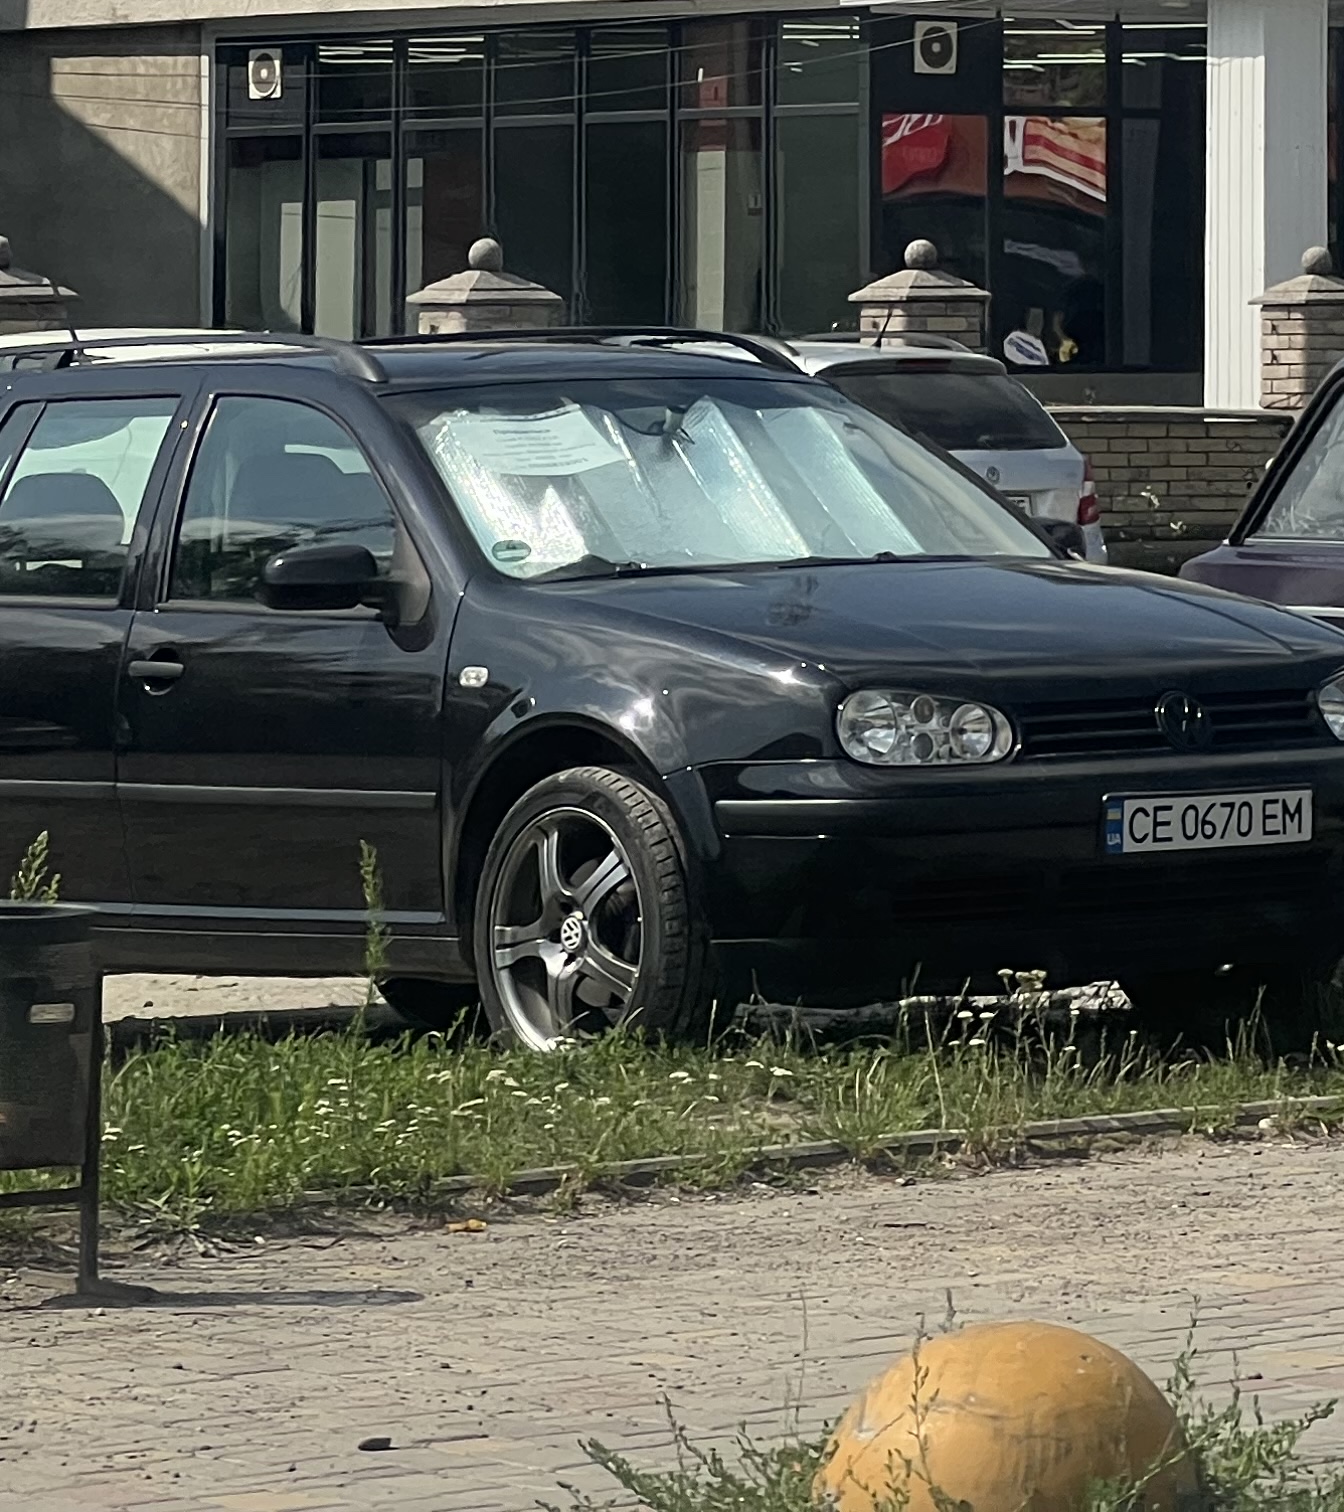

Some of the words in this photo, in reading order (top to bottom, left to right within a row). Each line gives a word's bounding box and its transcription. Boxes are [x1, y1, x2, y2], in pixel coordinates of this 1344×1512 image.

[1129, 806, 1173, 843] CE
[1181, 801, 1253, 840] 0670
[1263, 798, 1303, 835] EM
